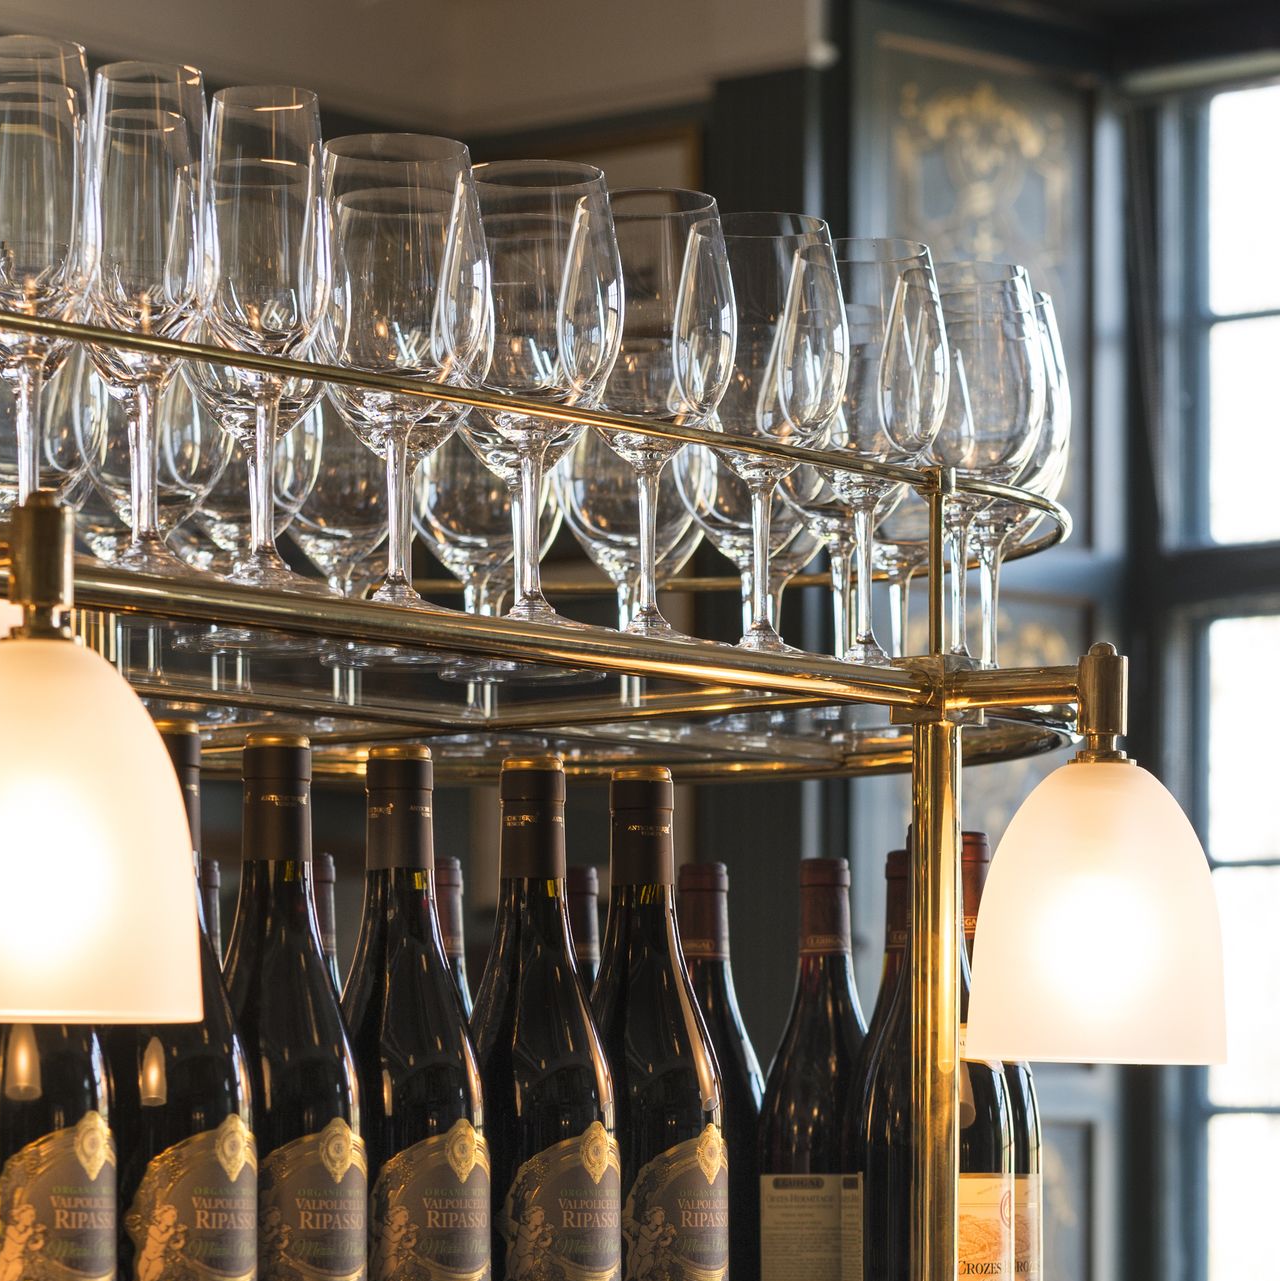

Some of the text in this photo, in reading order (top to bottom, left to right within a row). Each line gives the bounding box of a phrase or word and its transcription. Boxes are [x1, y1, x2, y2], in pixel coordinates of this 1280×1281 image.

[299, 1210, 363, 1230] RIPASSO
[426, 1210, 488, 1229] RIPASSO
[562, 1210, 619, 1228] RIPASSO
[958, 1260, 1002, 1276] CROZES
